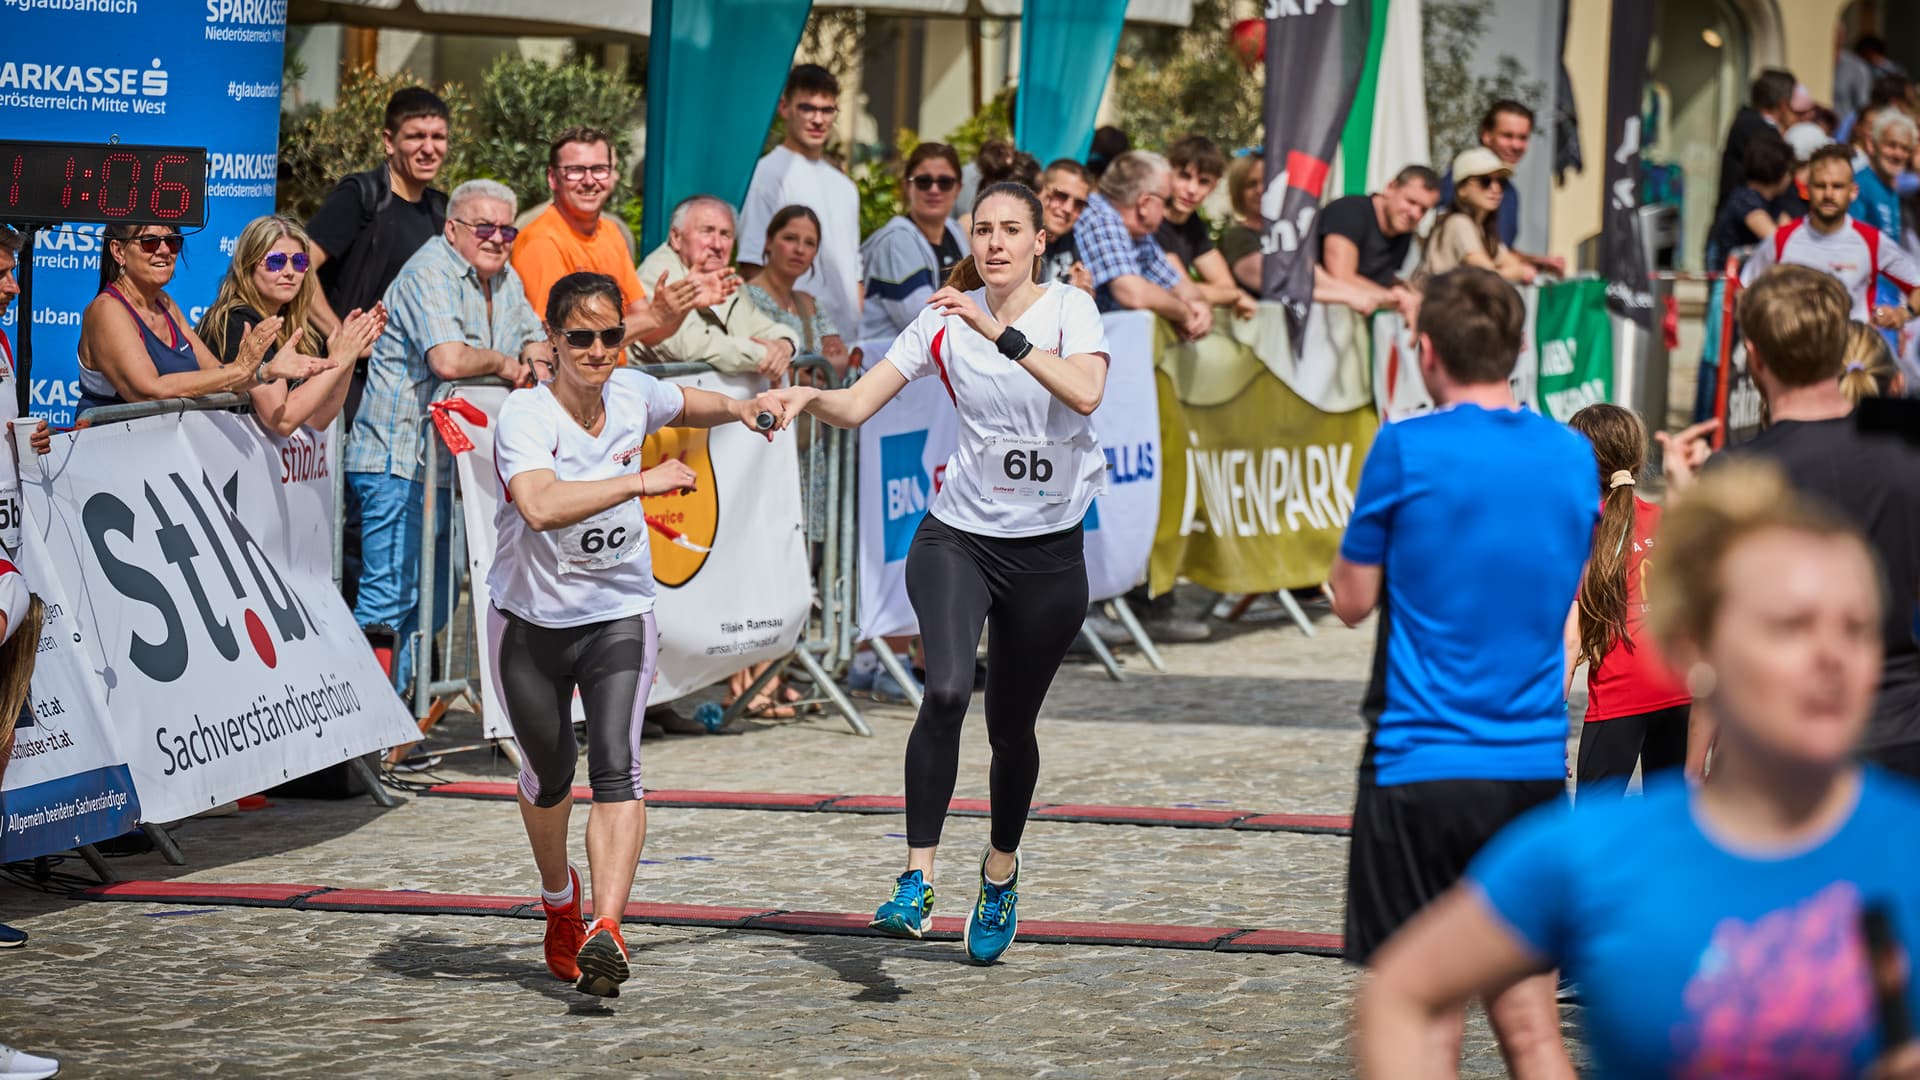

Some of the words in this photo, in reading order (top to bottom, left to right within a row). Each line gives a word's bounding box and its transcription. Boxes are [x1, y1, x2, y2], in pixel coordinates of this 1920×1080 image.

[92, 97, 129, 113] Mitte
[132, 98, 167, 114] West
[1003, 449, 1054, 484] 6b
[580, 526, 627, 555] 6c
[746, 618, 783, 631] Ramsau
[156, 673, 361, 776] Sachverständigenbüro
[8, 807, 46, 834] Allgemein
[44, 802, 75, 823] beeideter
[75, 789, 128, 816] Sachverständiger
